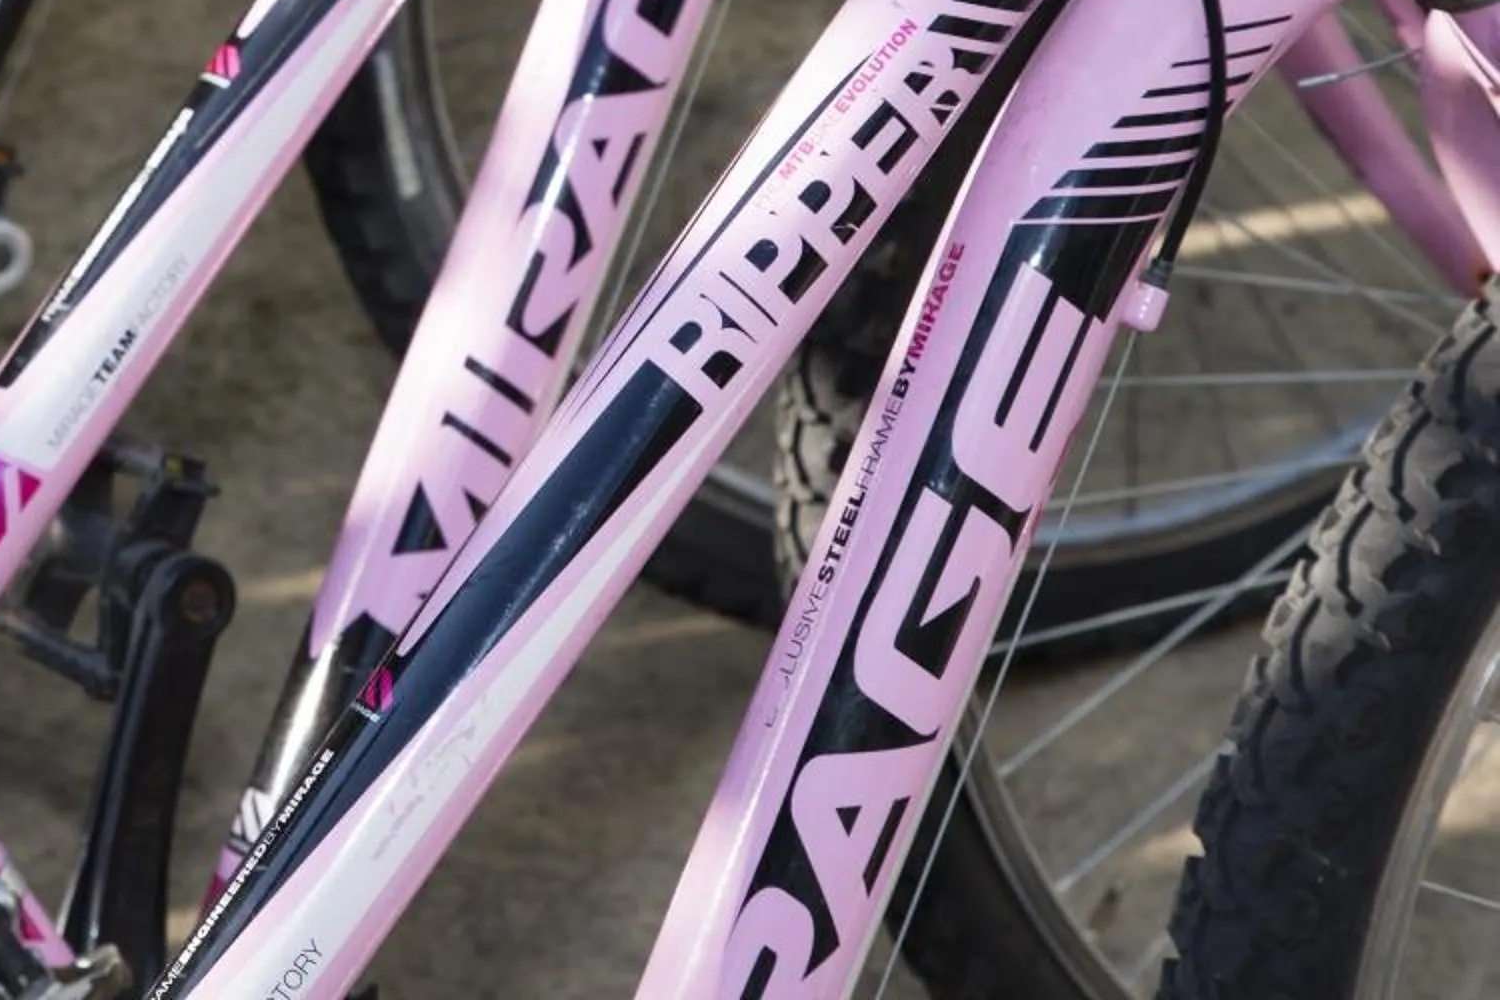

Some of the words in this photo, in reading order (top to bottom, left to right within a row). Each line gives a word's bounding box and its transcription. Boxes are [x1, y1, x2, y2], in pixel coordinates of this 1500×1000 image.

[833, 18, 919, 115] EVOLUTION
[646, 41, 982, 411] RIPPER
[266, 937, 323, 1000] TORY
